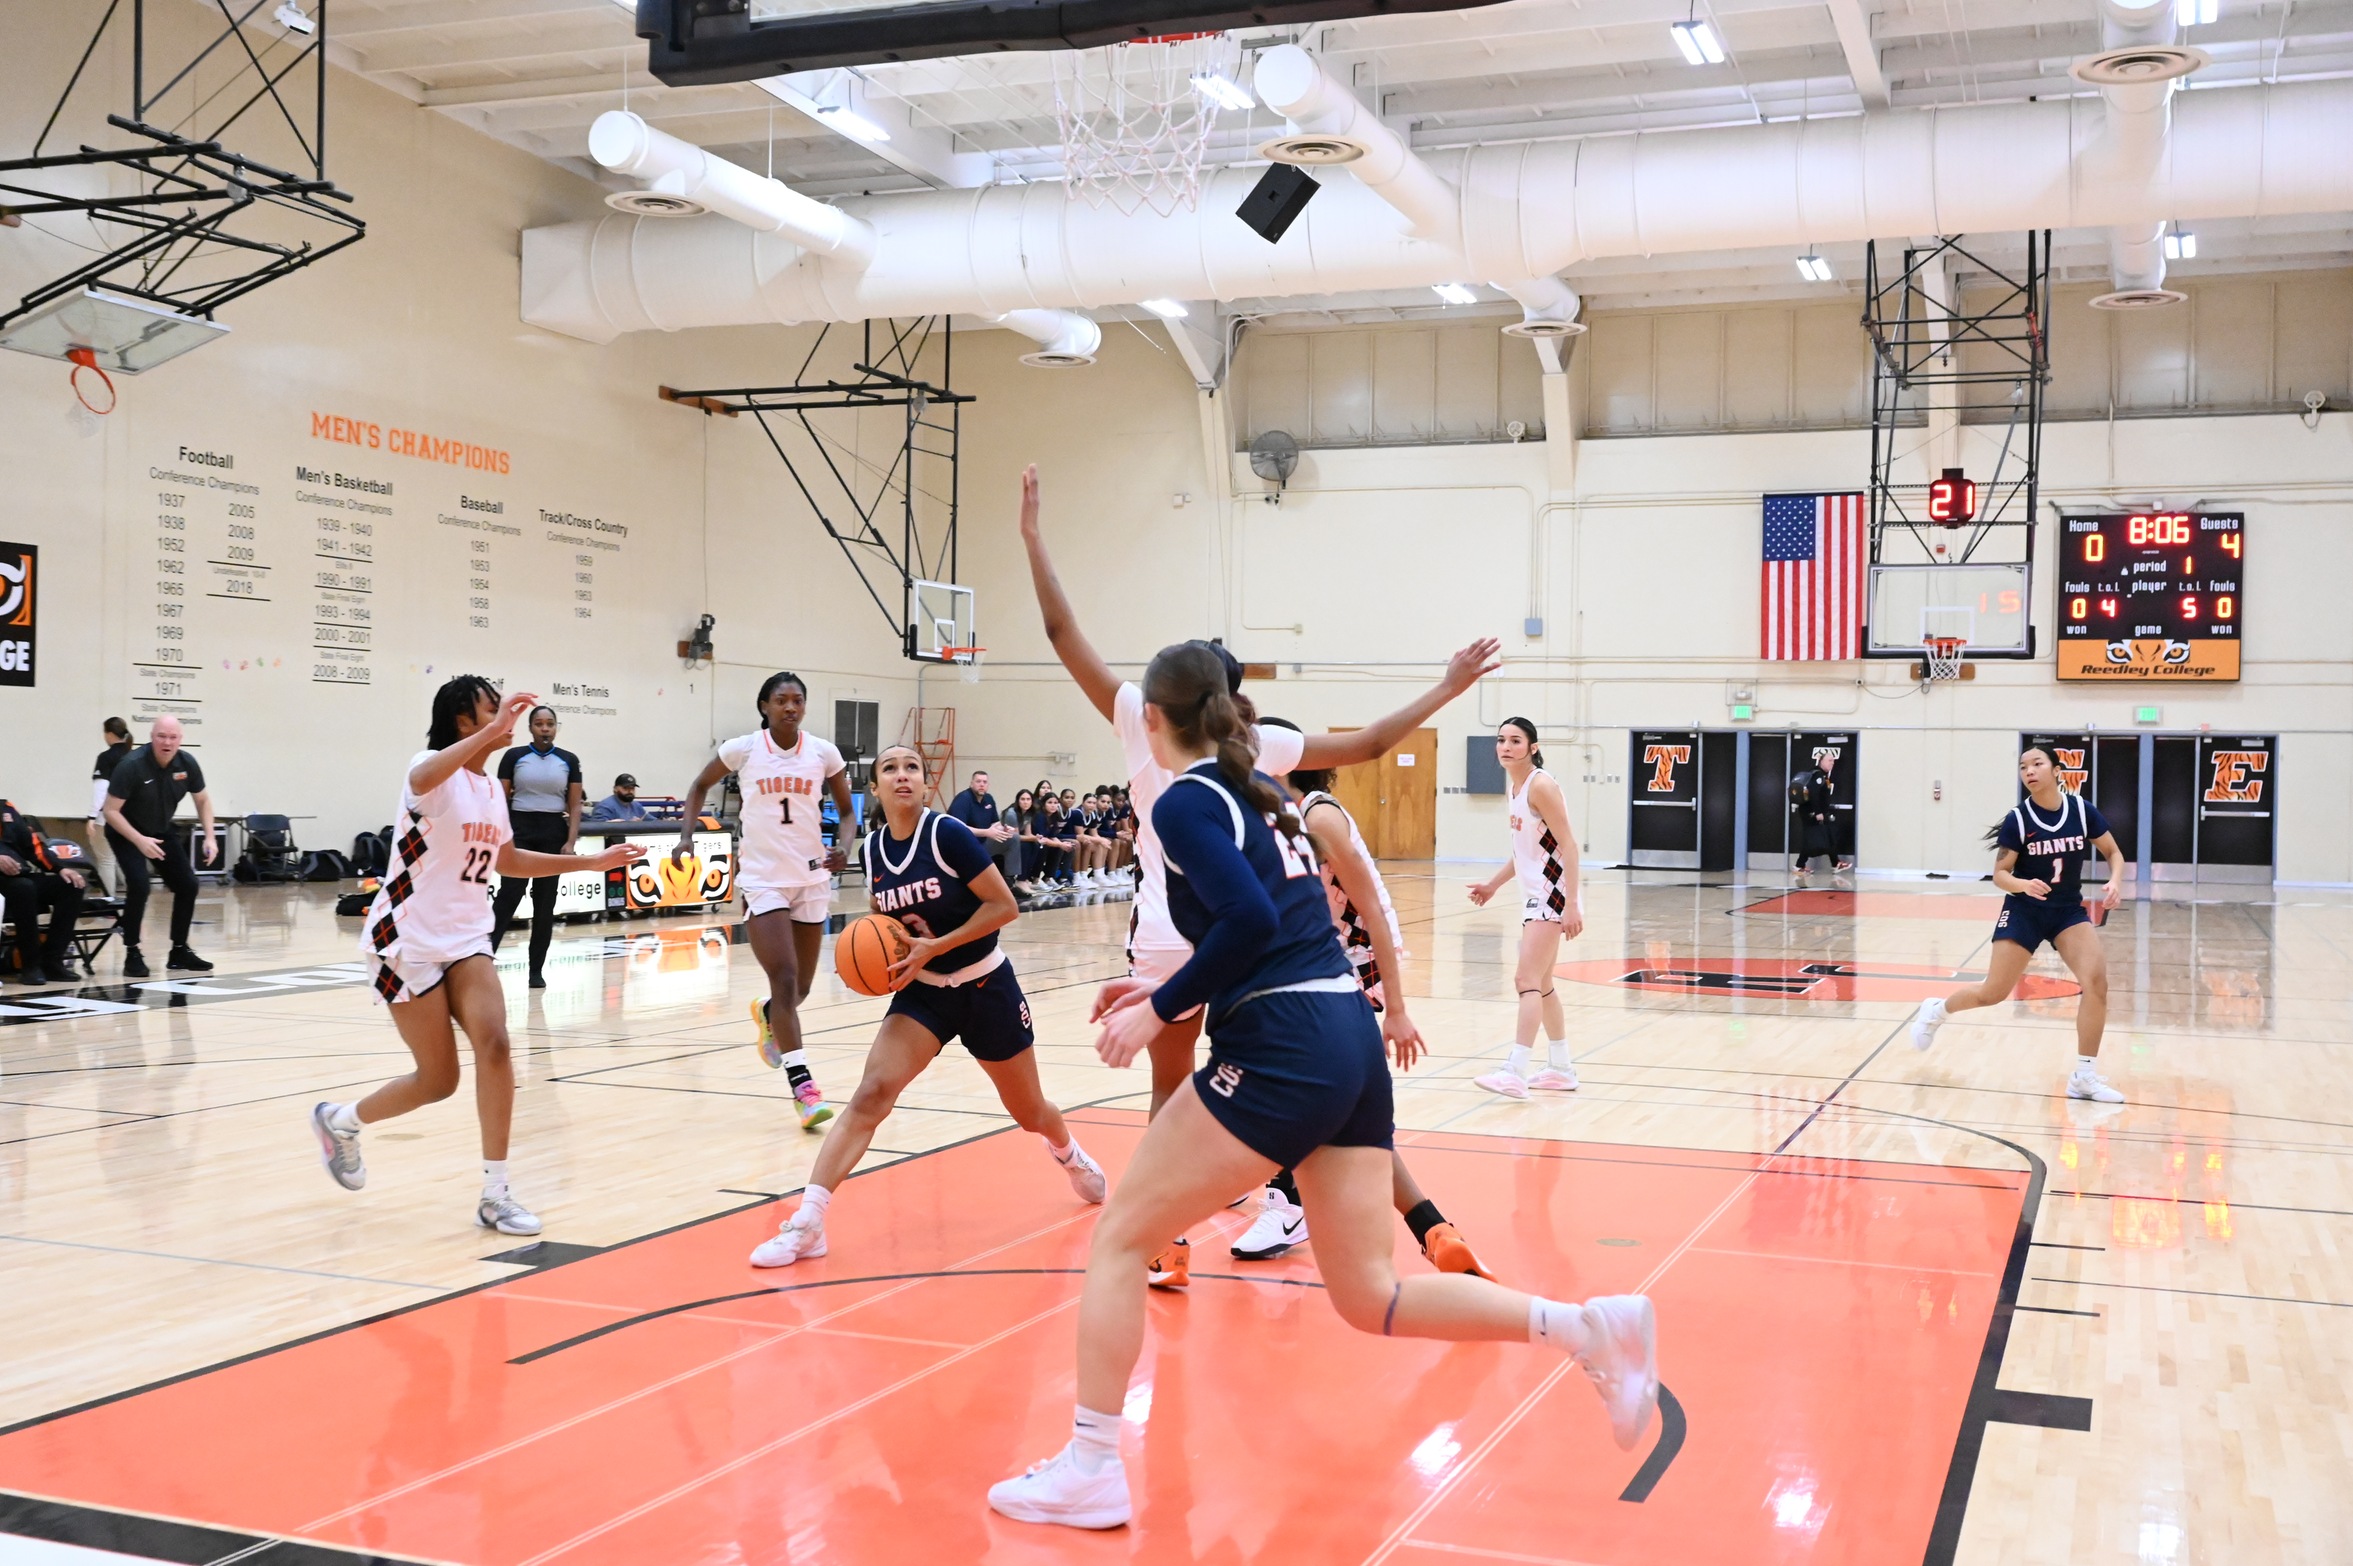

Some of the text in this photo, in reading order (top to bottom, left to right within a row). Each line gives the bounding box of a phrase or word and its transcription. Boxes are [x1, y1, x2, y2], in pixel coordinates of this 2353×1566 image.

[311, 410, 511, 475] MEN'S CHAMPIONS
[179, 446, 234, 469] Football
[149, 466, 260, 496] Conference Champions
[296, 466, 393, 496] Men's Basketball
[158, 492, 185, 508] 1937
[296, 490, 393, 516] Conference Champions
[460, 495, 504, 515] Baseball
[228, 502, 255, 519] 2005
[158, 514, 186, 530] 1938
[316, 517, 340, 532] 1939
[350, 522, 373, 537] 1940
[438, 513, 522, 537] Conference Champions
[539, 508, 628, 538] Track/Cross Country
[2069, 519, 2099, 532] Home
[2129, 516, 2190, 544] 8:06
[2200, 517, 2239, 530] Guests
[228, 524, 255, 540] 2008
[157, 536, 185, 552] 1952
[316, 538, 339, 552] 1941
[349, 542, 372, 557] 1942
[546, 530, 621, 552] Conference Champions
[2085, 534, 2104, 562] 0
[2222, 533, 2240, 559] 4
[227, 545, 254, 561] 2009
[157, 559, 185, 574] 1962
[2133, 559, 2167, 575] period
[2185, 556, 2192, 574] 1
[226, 579, 253, 594] 2018
[316, 572, 340, 586] 1990
[349, 576, 372, 589] 1991
[2065, 581, 2090, 593] fouls
[2132, 580, 2167, 593] player
[2209, 580, 2236, 592] fouls
[156, 603, 184, 618] 1967
[315, 604, 339, 618] 1993
[348, 608, 371, 621] 1994
[2072, 598, 2086, 619] 0
[2101, 599, 2116, 618] 4
[2182, 597, 2197, 619] 5
[2217, 597, 2232, 618] 0
[156, 625, 184, 640] 1969
[314, 627, 339, 641] 2000
[348, 630, 371, 643] 2001
[2066, 625, 2087, 634] won
[2134, 625, 2162, 636] game
[2211, 625, 2232, 634] won
[156, 647, 184, 662] 1970
[313, 664, 338, 678] 2008
[347, 666, 370, 680] 2009
[2081, 665, 2216, 678] Reedley College
[155, 681, 182, 695] 1971
[553, 682, 609, 698] Men's Tennis
[1643, 744, 1691, 792] T
[2204, 751, 2269, 802] E
[756, 776, 813, 796] TIGERS
[779, 797, 793, 824] 1
[2027, 835, 2085, 857] GIANTS
[460, 847, 492, 884] 22
[2051, 858, 2064, 884] 1
[560, 881, 602, 900] ollege
